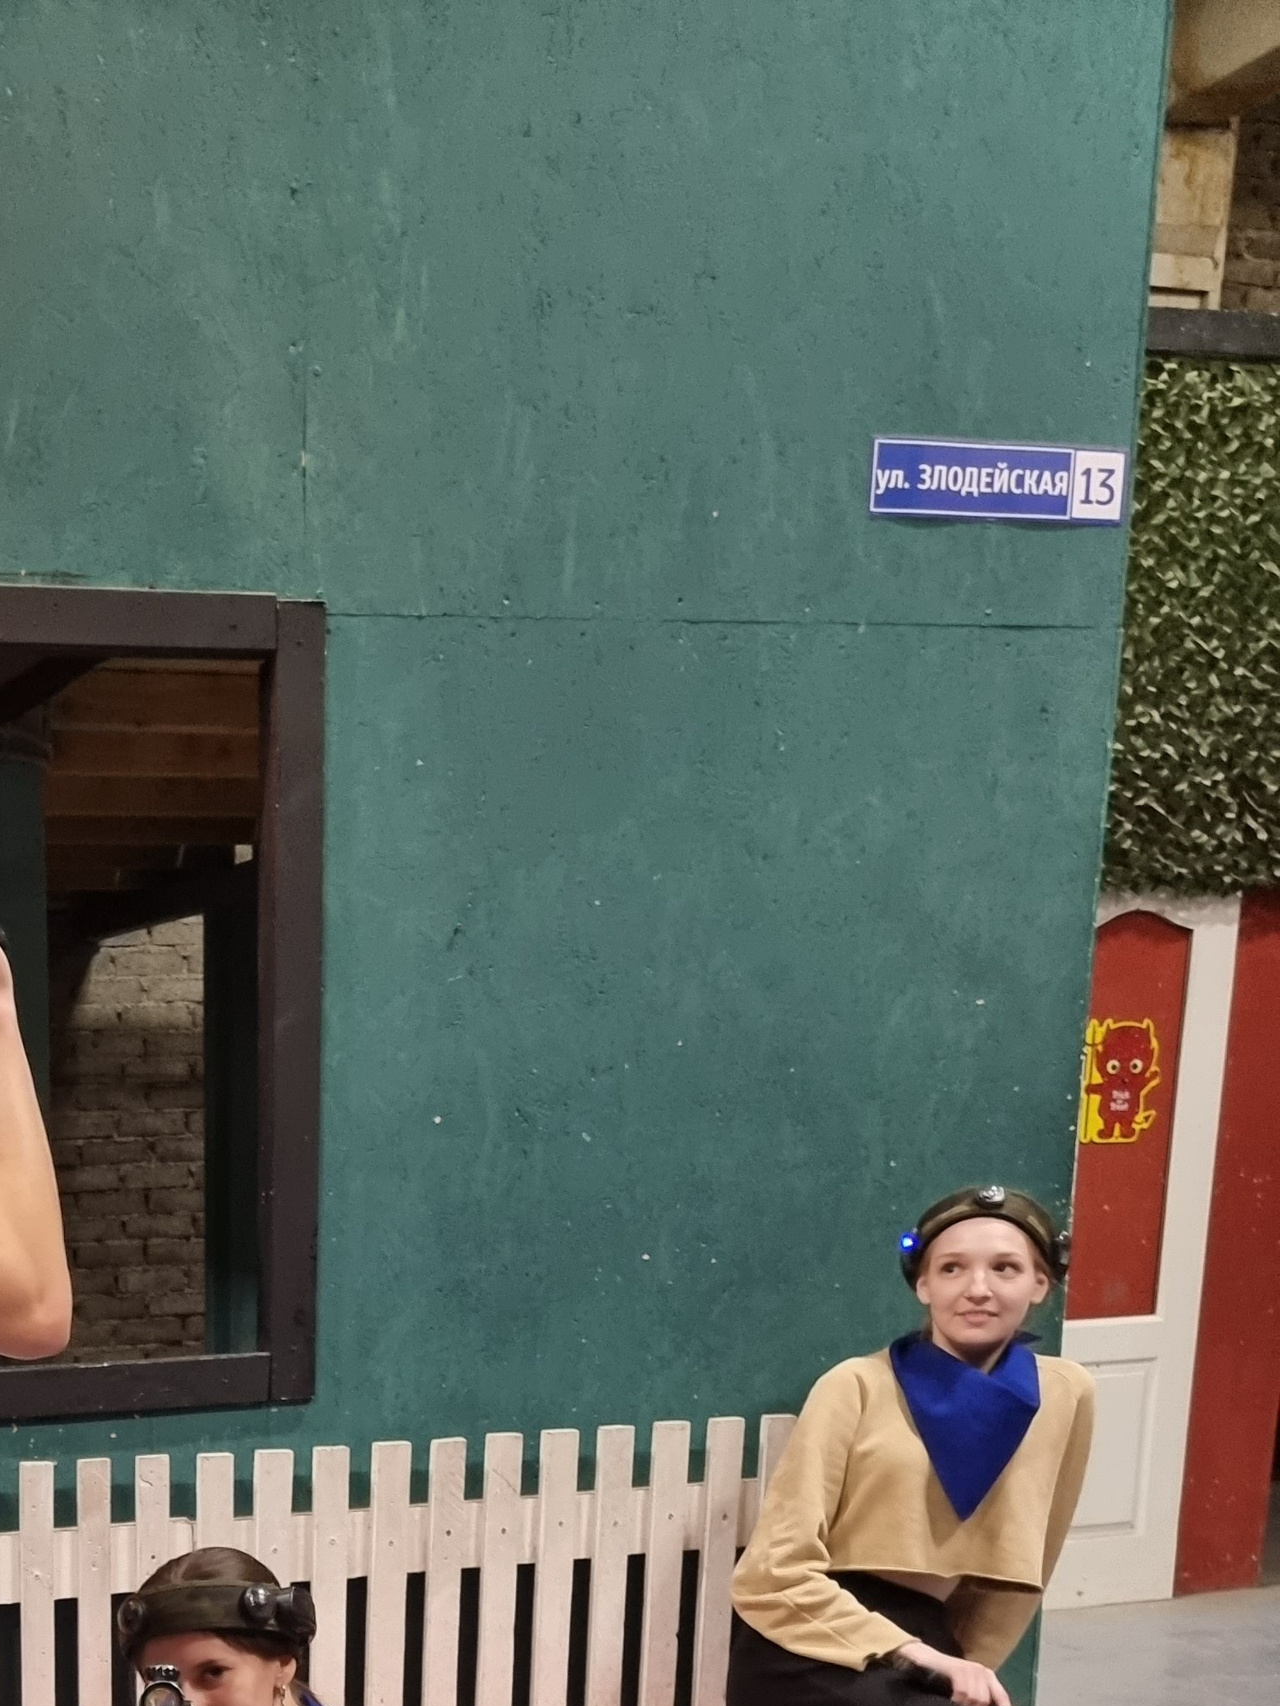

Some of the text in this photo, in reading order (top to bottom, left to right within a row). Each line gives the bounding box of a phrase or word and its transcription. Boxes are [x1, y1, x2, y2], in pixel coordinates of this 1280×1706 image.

[875, 462, 1116, 506] ул. ЗЛОДЕЙСКАЯ 13
